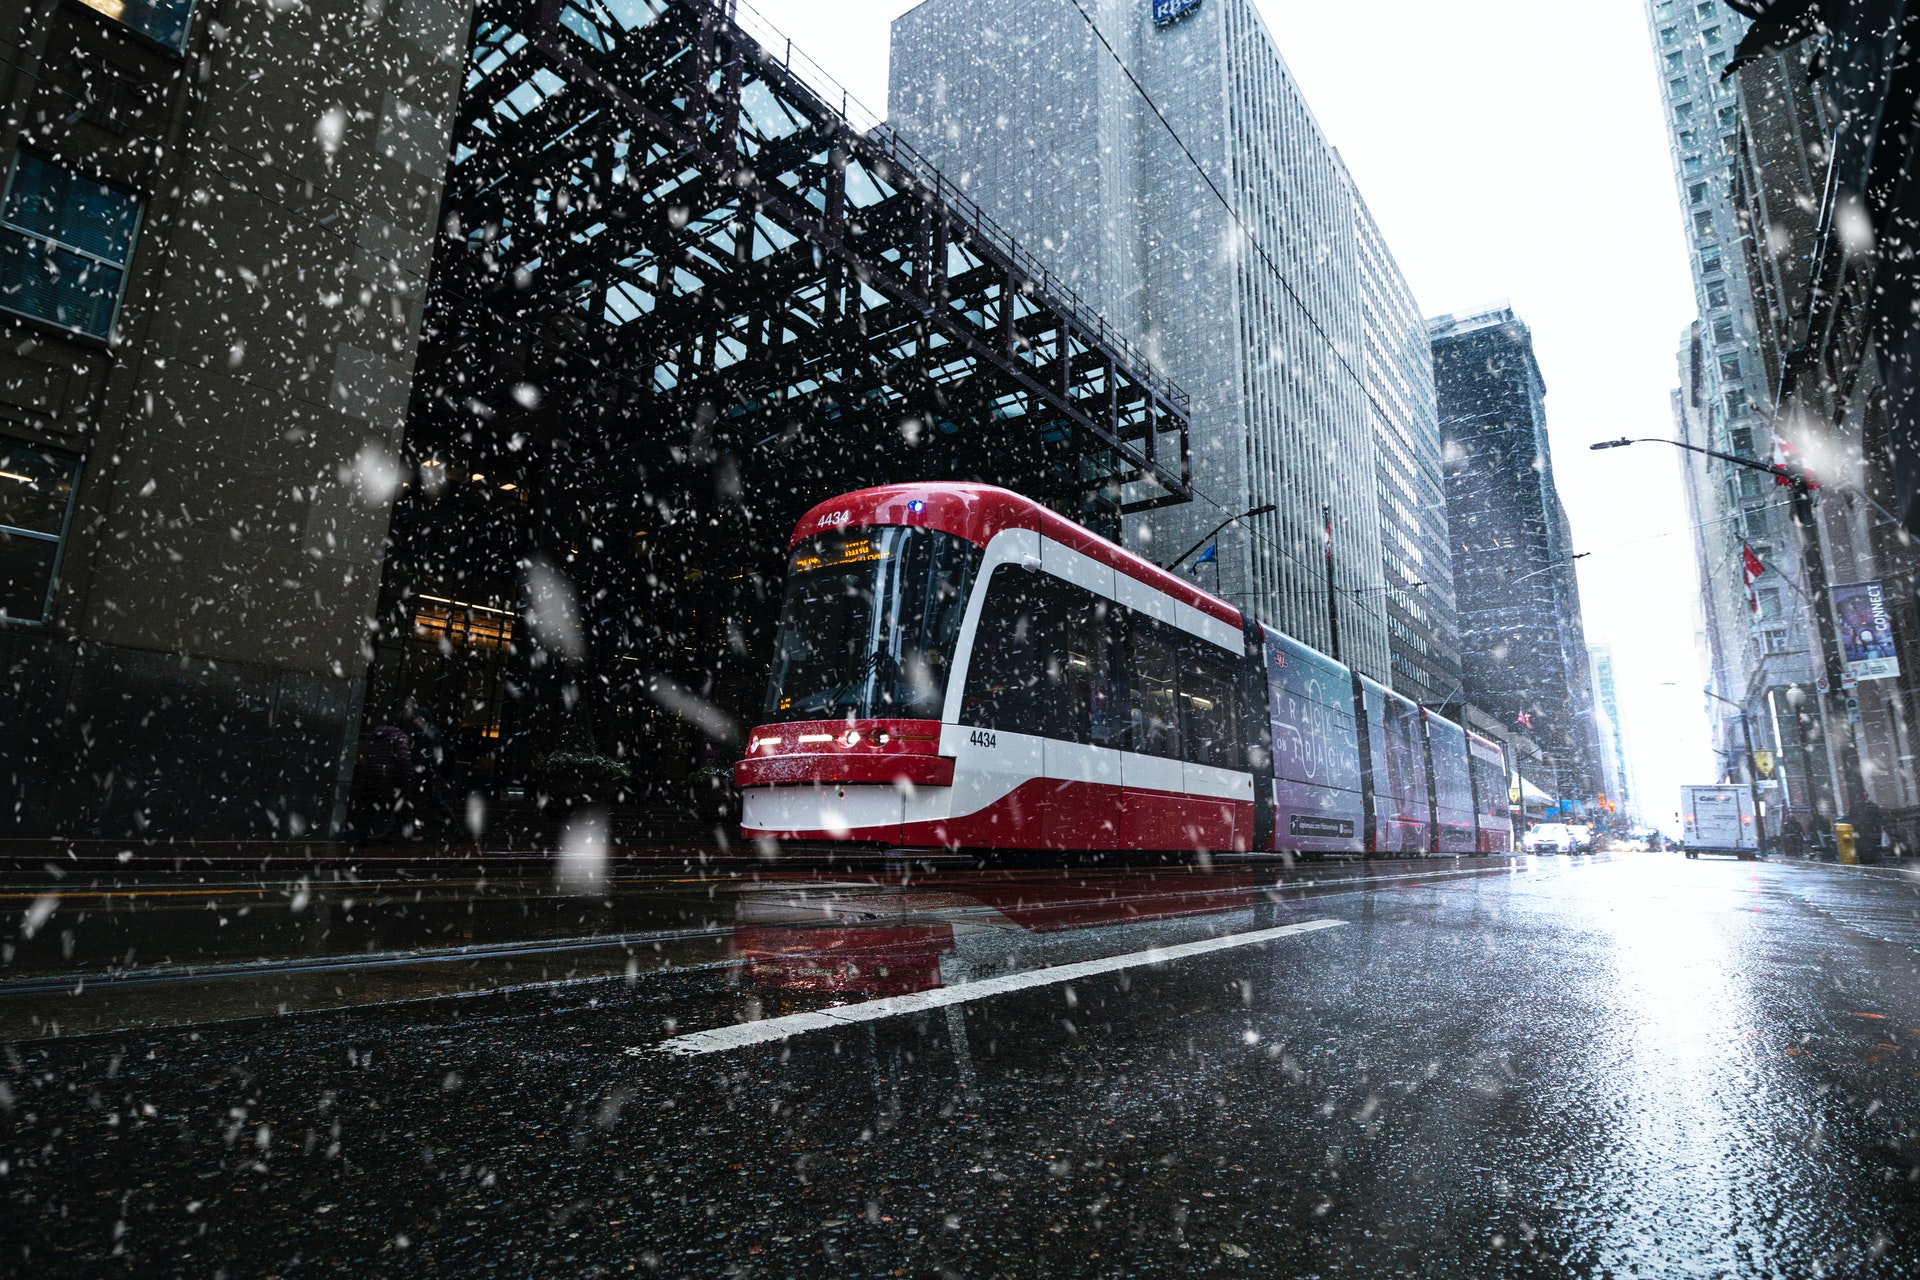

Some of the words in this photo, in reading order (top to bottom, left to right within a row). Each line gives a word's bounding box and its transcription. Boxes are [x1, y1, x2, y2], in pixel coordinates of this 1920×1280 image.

[1157, 0, 1193, 18] RB
[817, 509, 849, 528] 4434
[1867, 585, 1888, 631] CONNECT
[969, 730, 997, 749] 4434
[1276, 737, 1287, 752] ON
